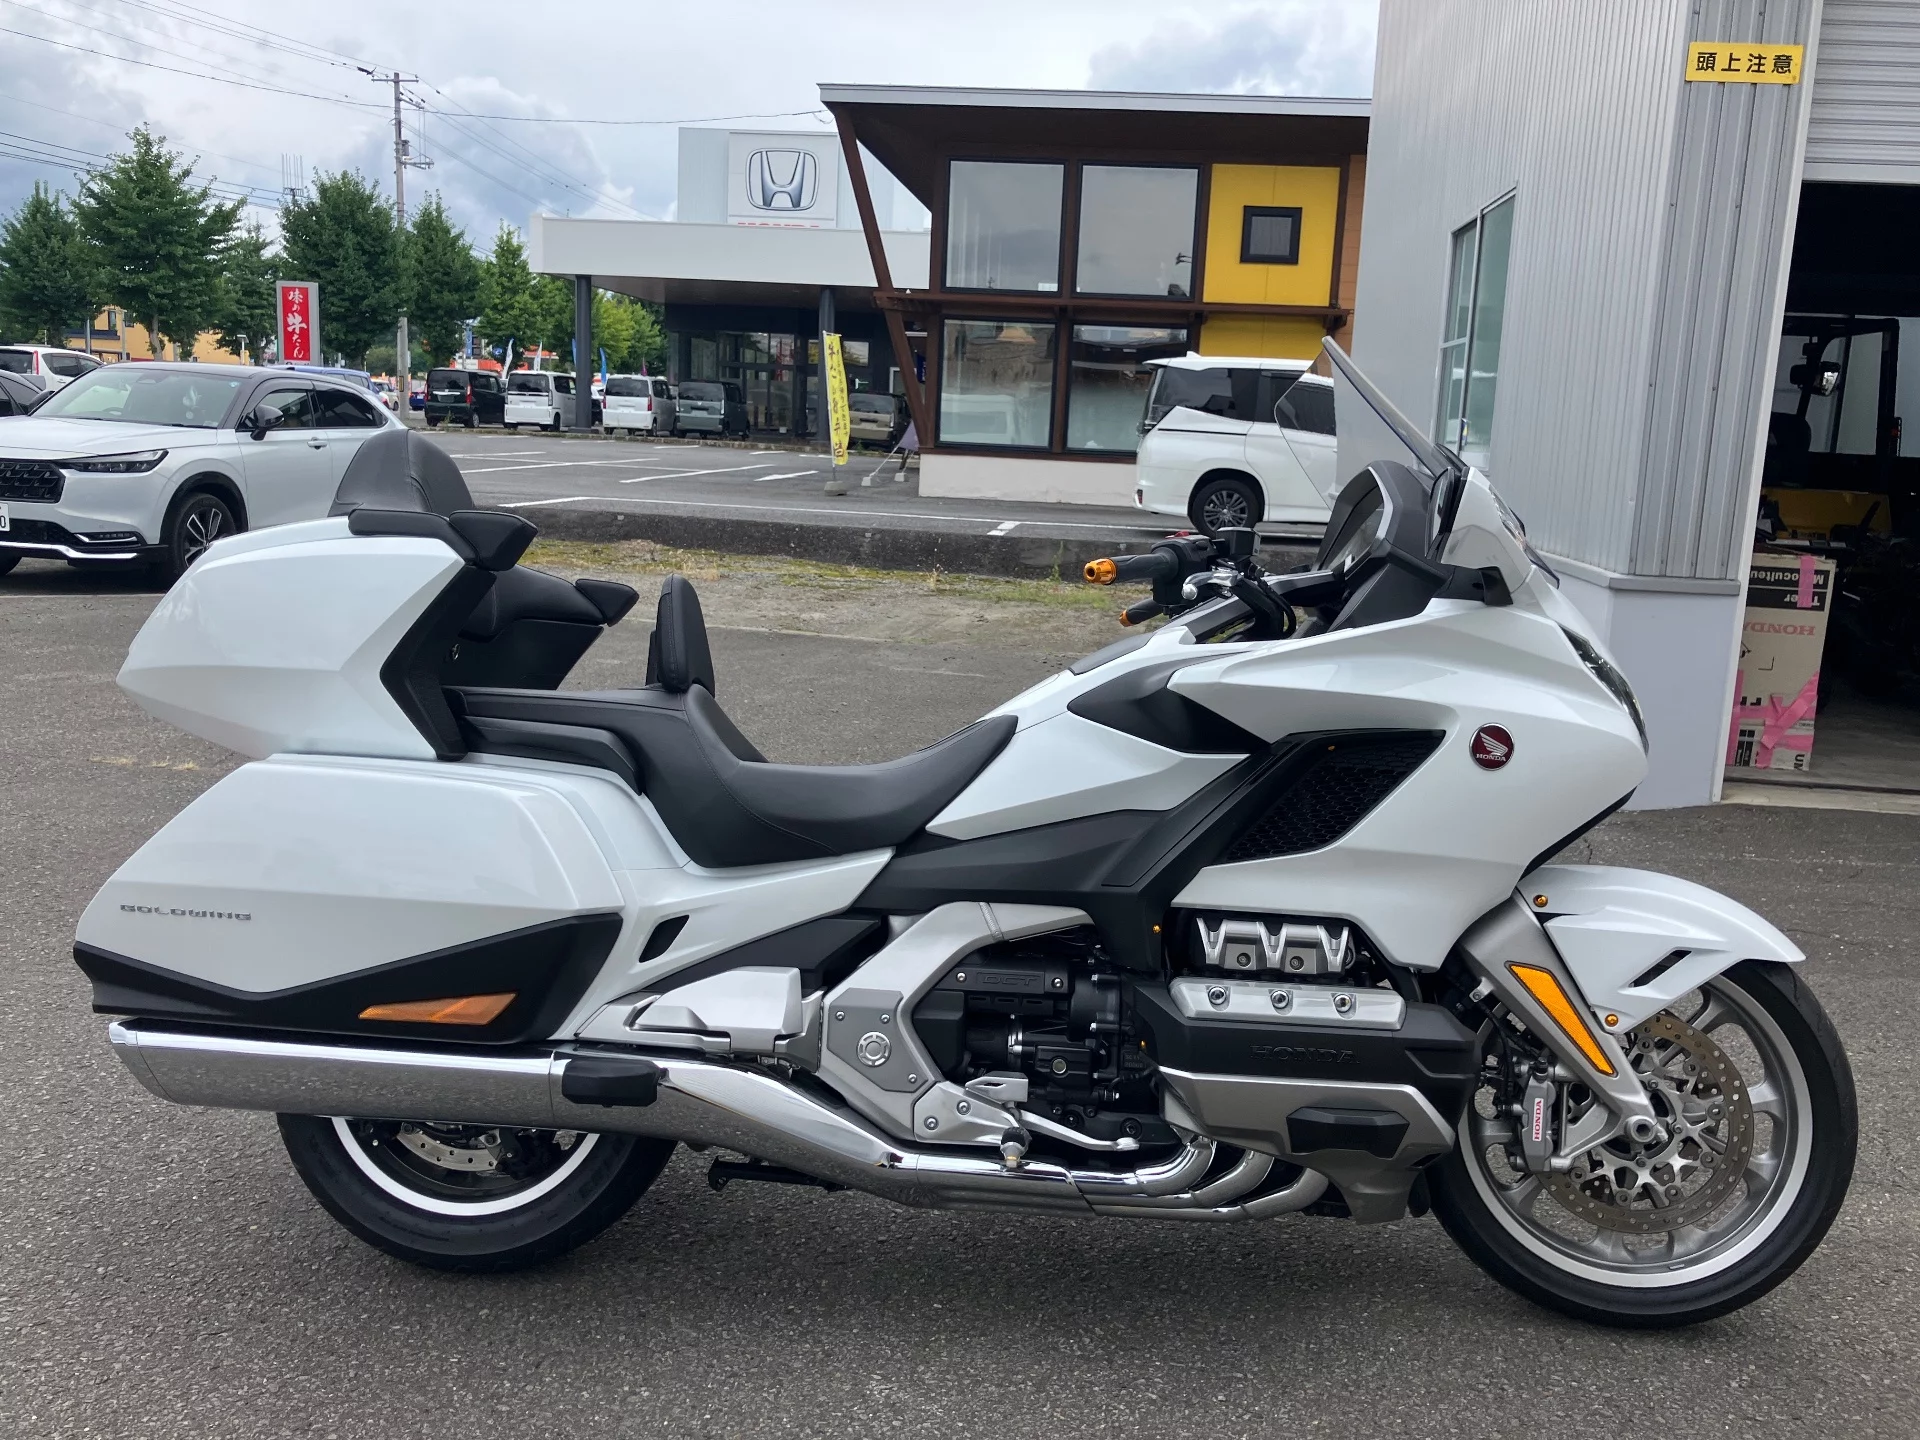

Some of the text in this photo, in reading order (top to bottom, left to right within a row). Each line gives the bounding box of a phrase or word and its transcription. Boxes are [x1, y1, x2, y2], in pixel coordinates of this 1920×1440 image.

[1695, 51, 1793, 74] 頭上注意
[287, 288, 307, 358] 味の牛たん
[1783, 593, 1821, 607] Ter
[1476, 753, 1506, 761] HONDA
[120, 904, 252, 921] GOLDWING
[982, 975, 1037, 986] DCT
[1250, 1045, 1361, 1064] HONDA
[1534, 1100, 1542, 1140] HONDA
